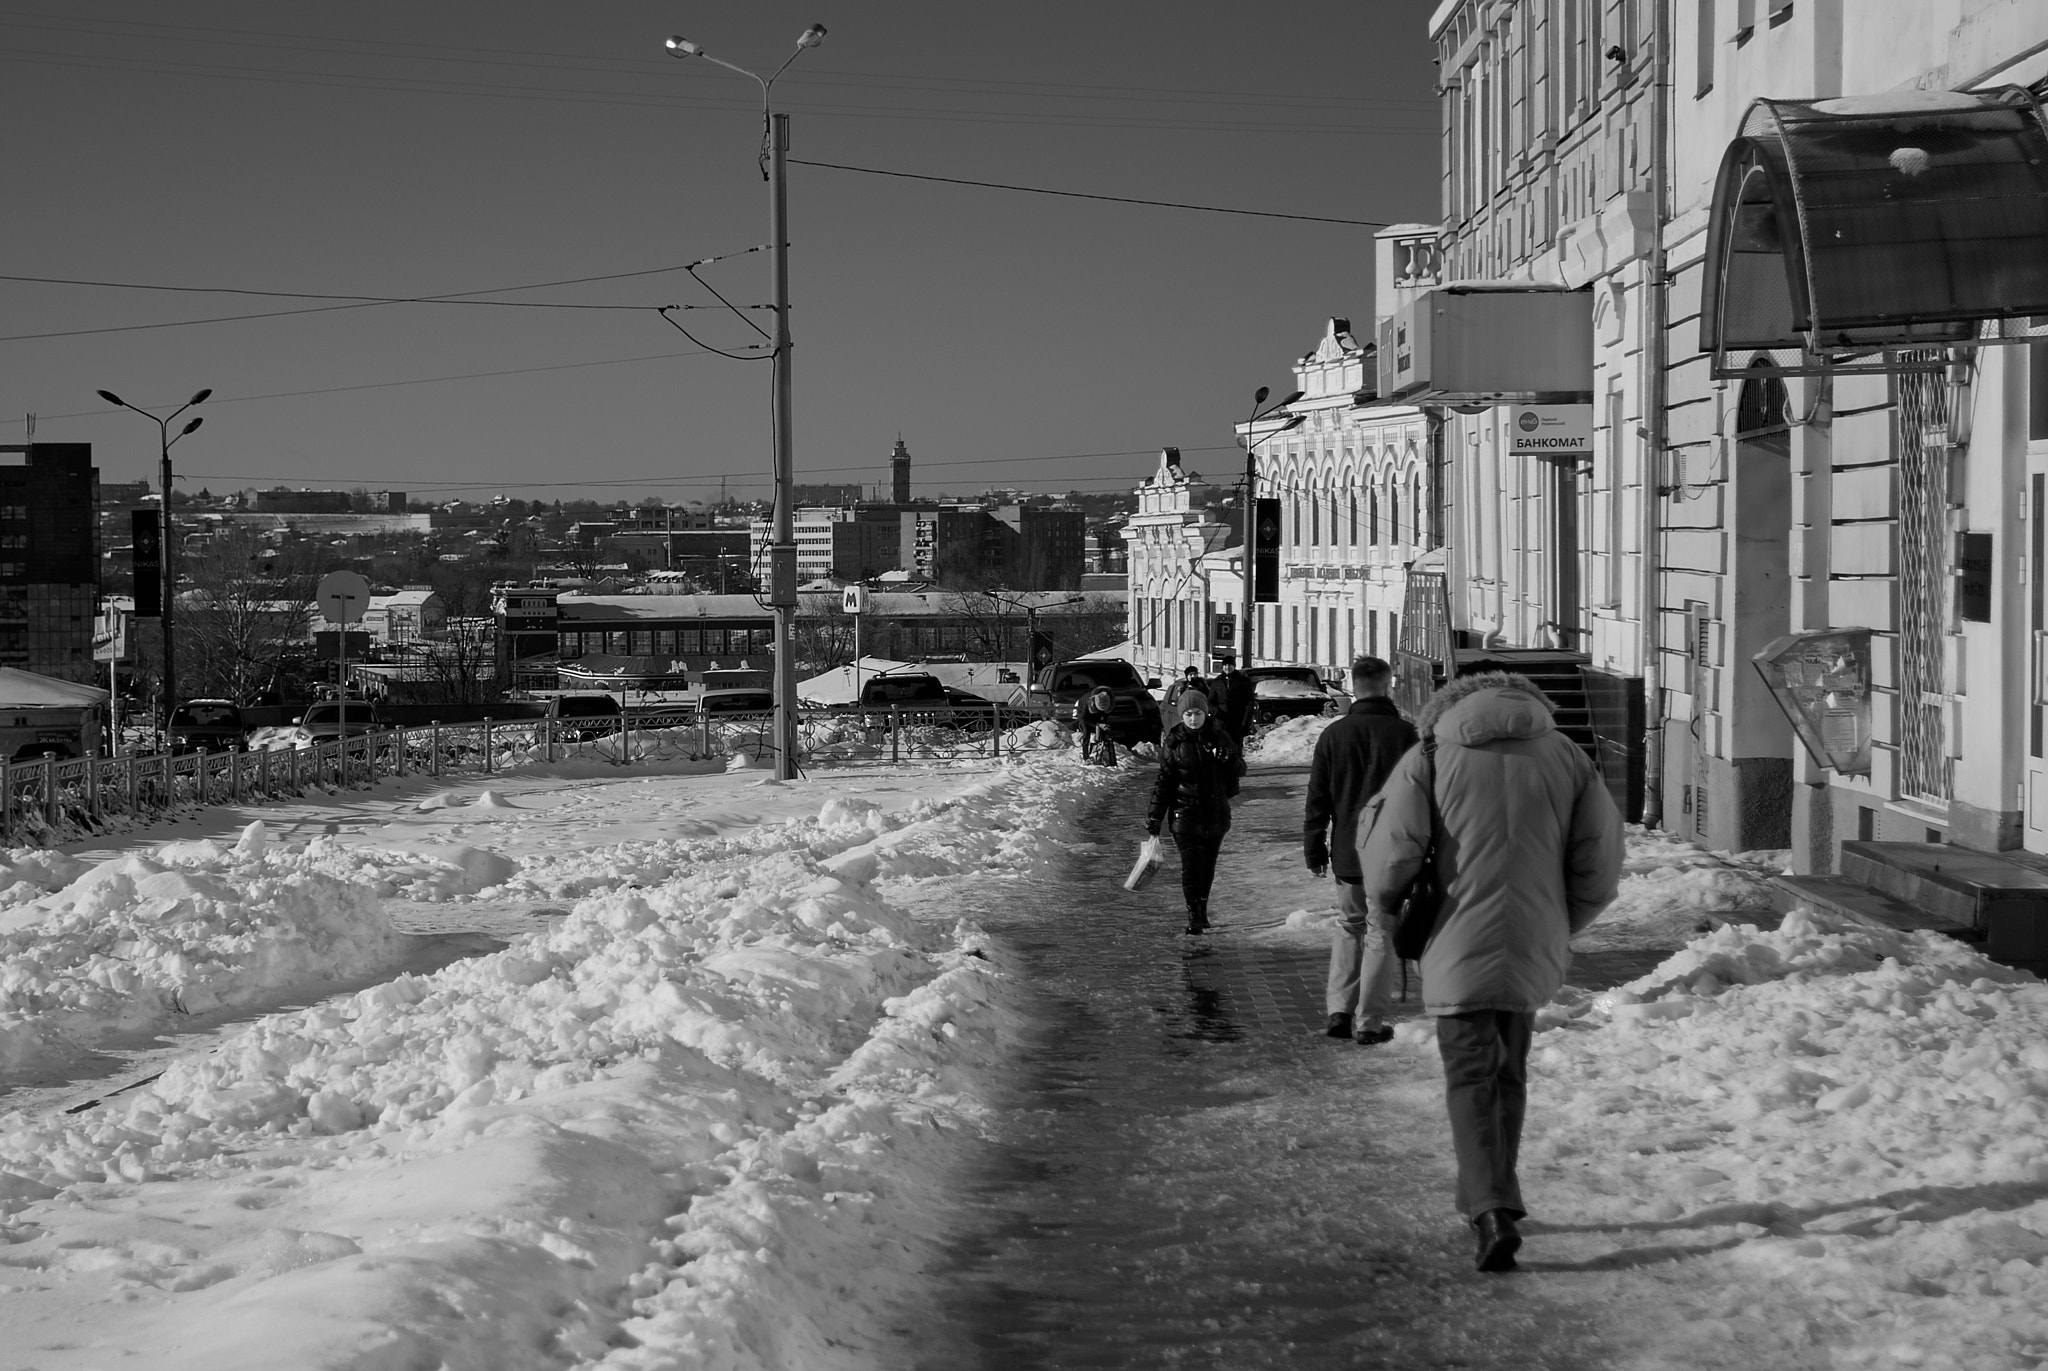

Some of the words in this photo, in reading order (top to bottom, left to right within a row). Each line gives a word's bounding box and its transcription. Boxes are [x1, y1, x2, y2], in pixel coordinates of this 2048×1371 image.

[1516, 437, 1585, 448] БАНКОМАТ
[1256, 547, 1279, 555] NIKAS
[133, 560, 160, 568] NIKAS
